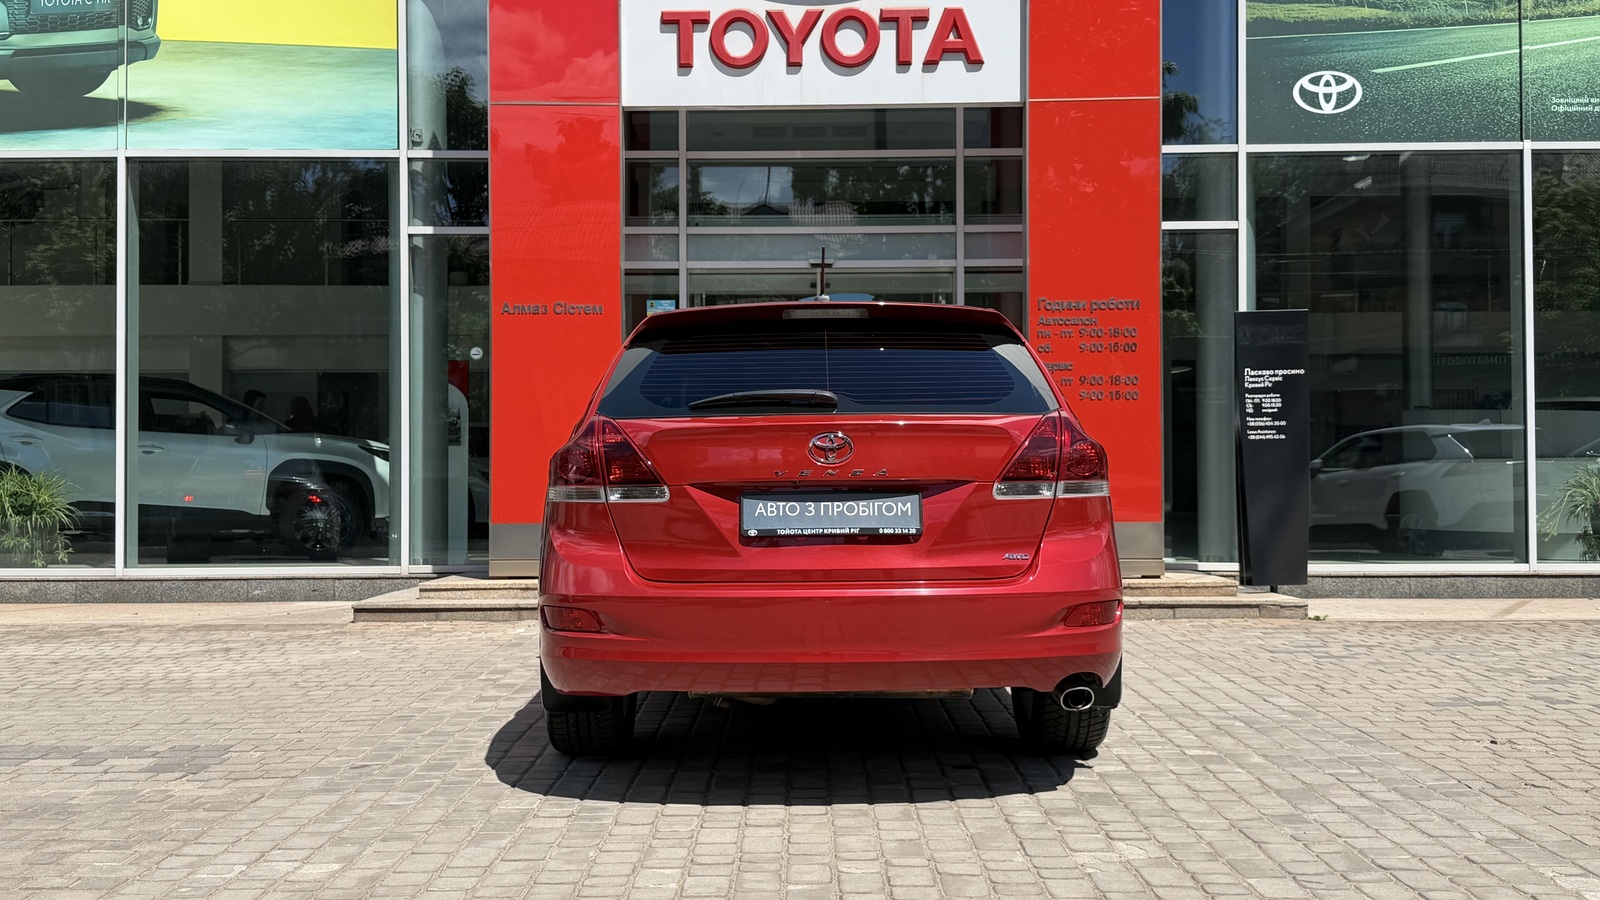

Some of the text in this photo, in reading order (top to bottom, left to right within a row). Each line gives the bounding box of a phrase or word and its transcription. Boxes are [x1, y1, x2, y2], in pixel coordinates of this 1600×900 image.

[661, 8, 984, 69] TOYOTA
[1551, 104, 1593, 112] Офіційний
[501, 302, 603, 315] Алмаз Сістем
[1037, 298, 1140, 314] Години роботи
[1037, 316, 1098, 326] Автосалон
[1043, 362, 1074, 374] ервіс
[1244, 368, 1274, 376] Ласкаво
[773, 468, 889, 477] VENZA
[755, 502, 912, 517] АВТО З ПРОБІГОМ
